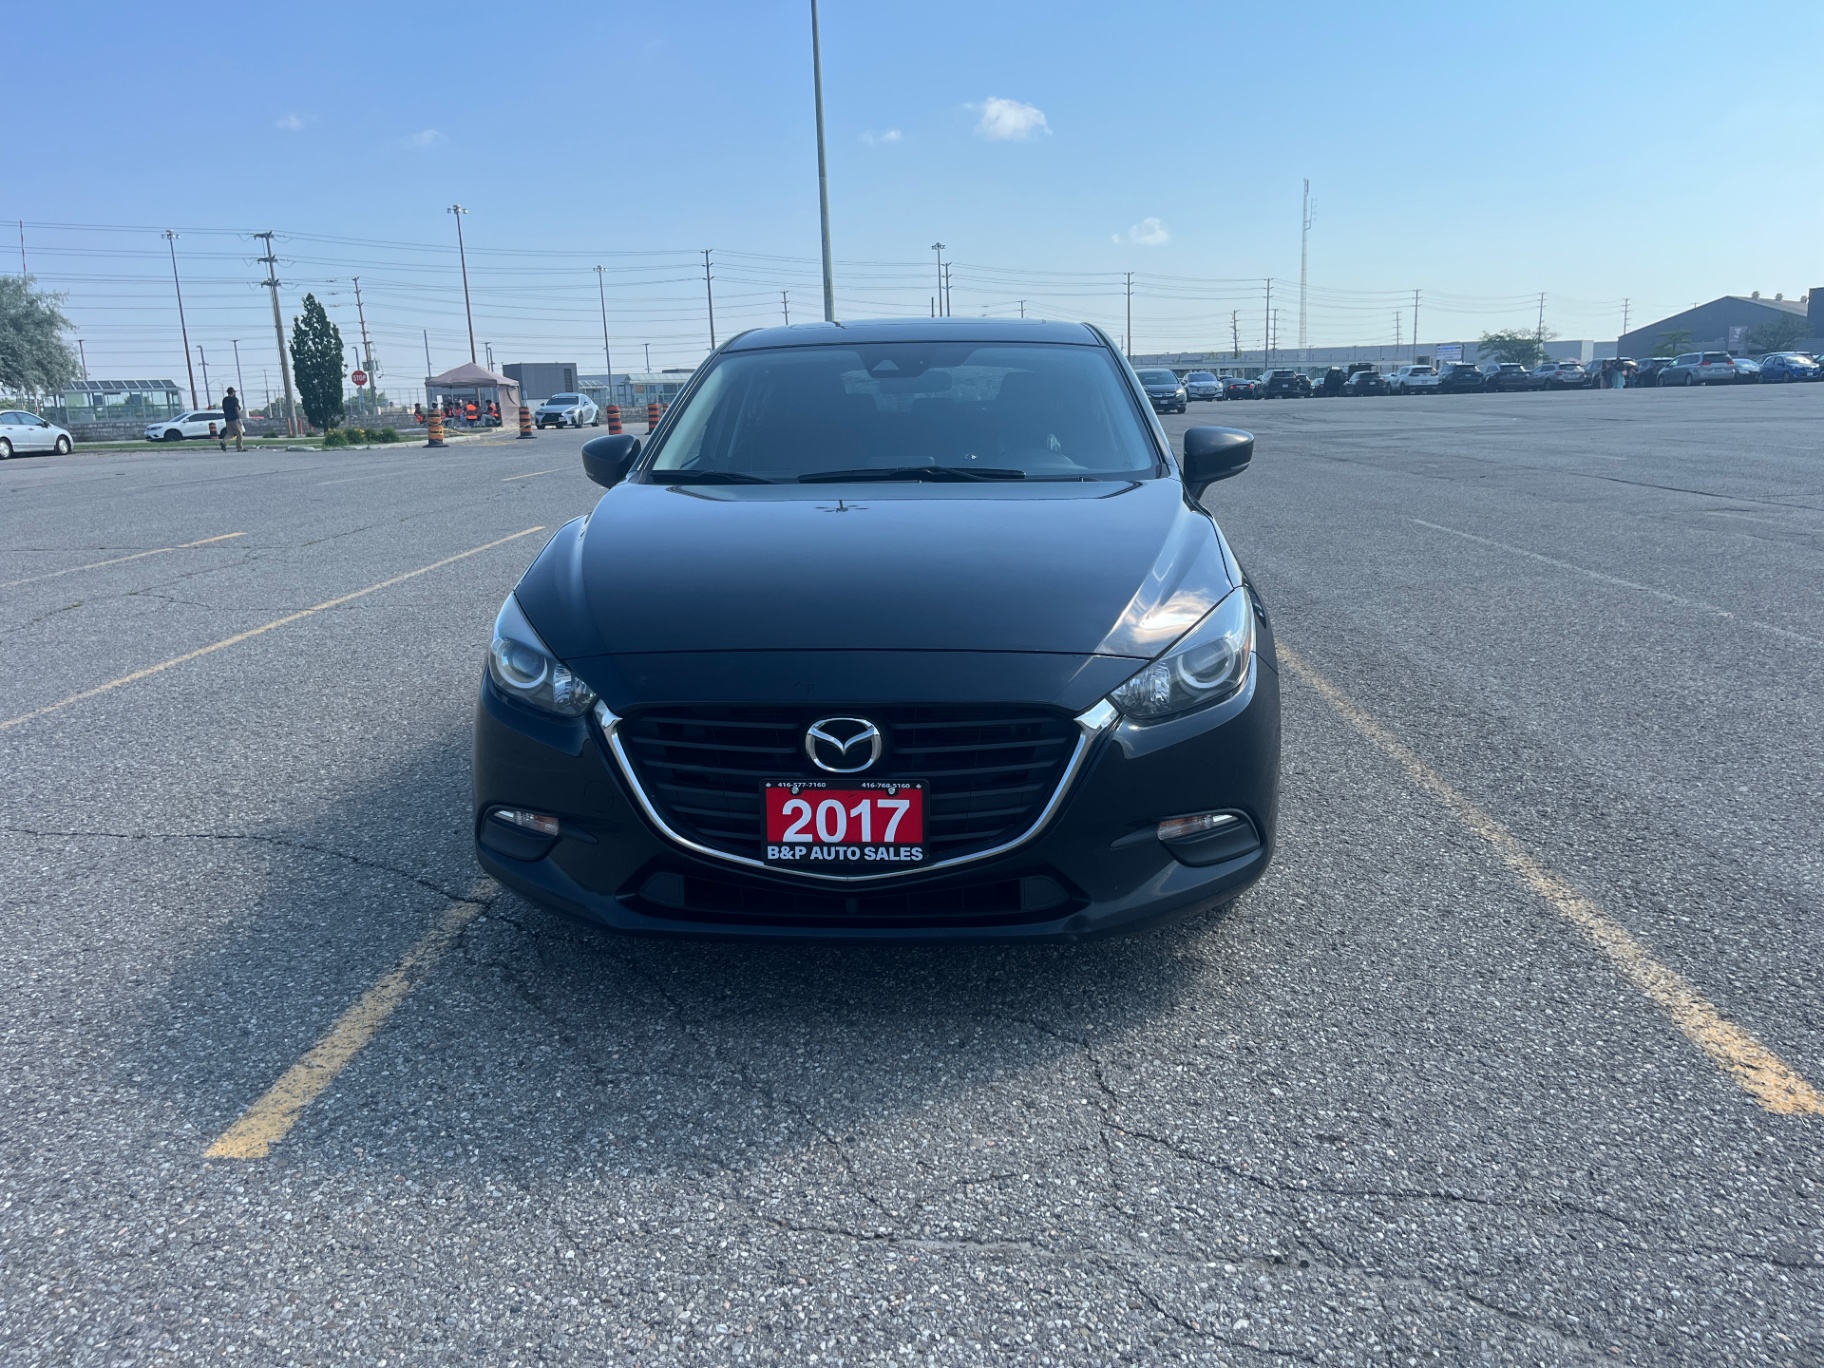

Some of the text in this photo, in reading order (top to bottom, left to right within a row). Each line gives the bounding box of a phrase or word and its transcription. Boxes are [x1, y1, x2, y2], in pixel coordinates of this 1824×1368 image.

[782, 799, 910, 843] 2017
[767, 846, 923, 861] B&P AUTO SALES
